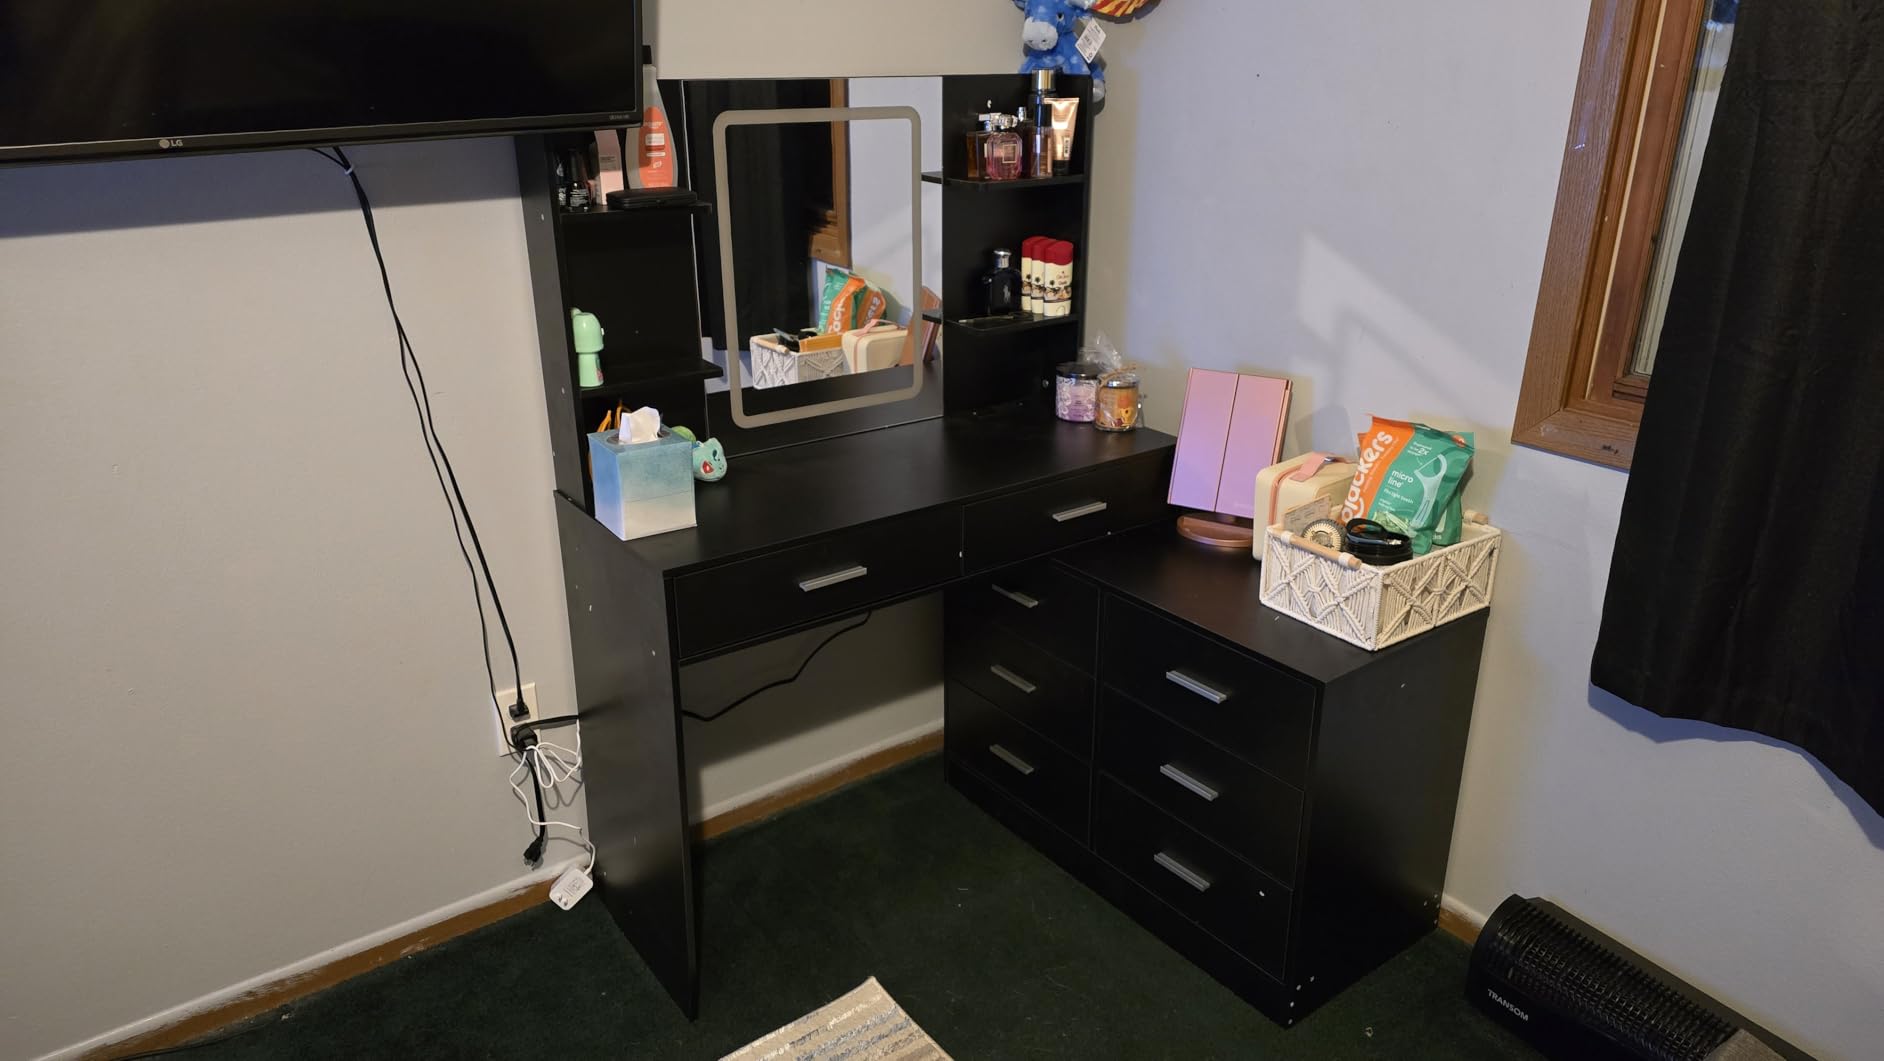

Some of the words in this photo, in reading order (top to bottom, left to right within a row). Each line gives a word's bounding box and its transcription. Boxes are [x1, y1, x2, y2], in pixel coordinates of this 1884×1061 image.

[170, 139, 184, 147] LG
[1387, 476, 1402, 488] line
[1391, 470, 1414, 483] micro
[1487, 988, 1529, 1021] TRANSOM
